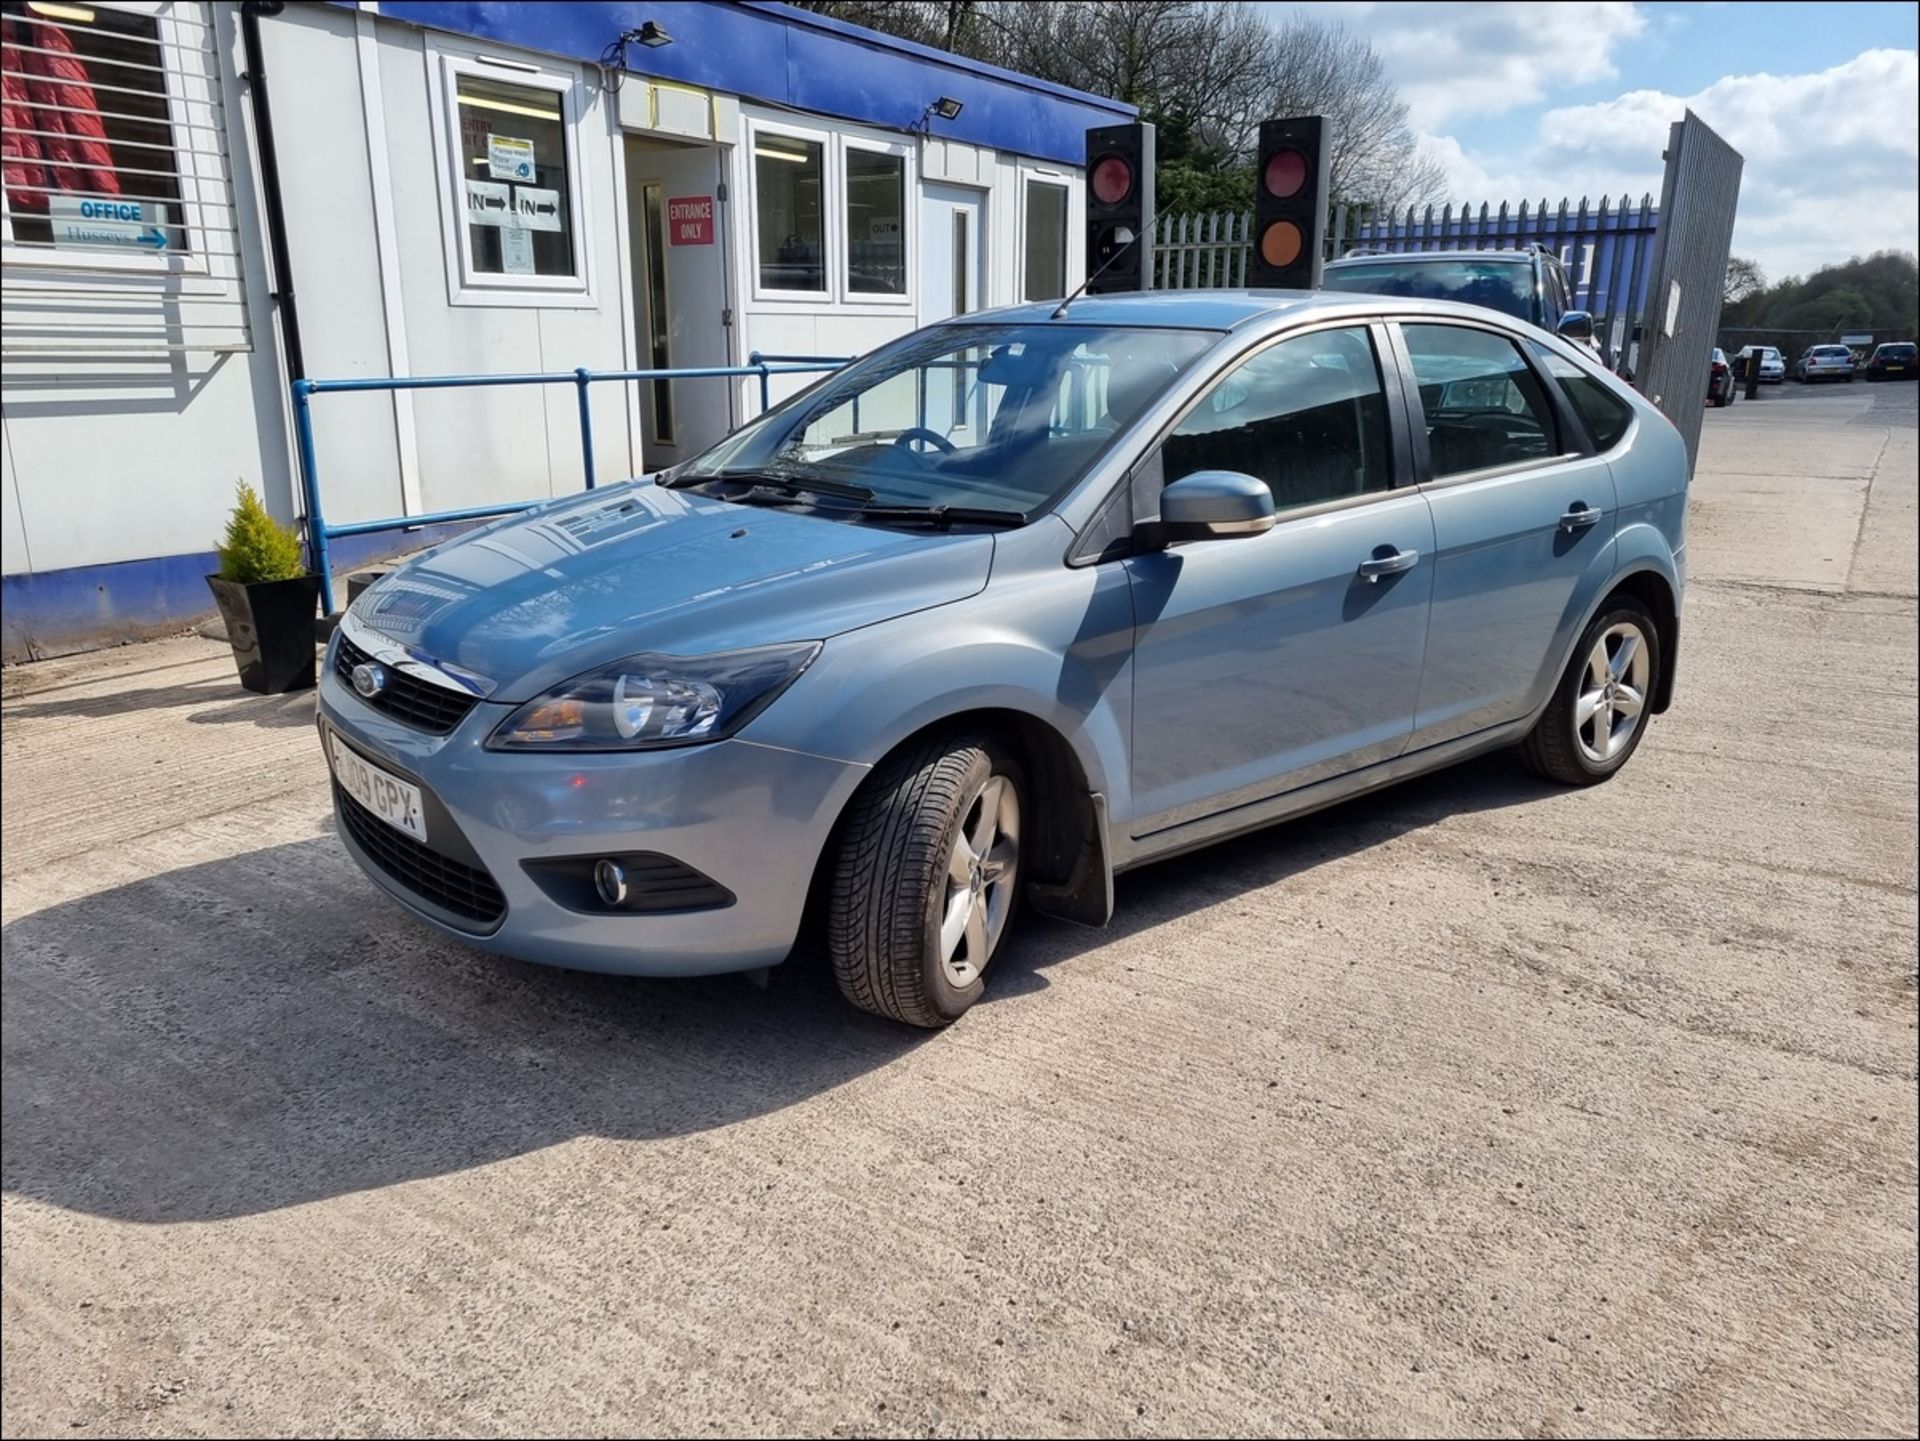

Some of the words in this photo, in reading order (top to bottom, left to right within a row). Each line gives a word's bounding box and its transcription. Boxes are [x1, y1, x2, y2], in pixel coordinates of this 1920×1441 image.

[467, 192, 485, 210] IN
[519, 199, 536, 216] IN
[81, 201, 142, 221] OFFICE
[670, 202, 711, 220] ENTRANCE
[66, 226, 132, 243] Husseys
[680, 223, 702, 239] ONLY
[872, 223, 889, 234] OUT
[373, 773, 416, 830] GPX
